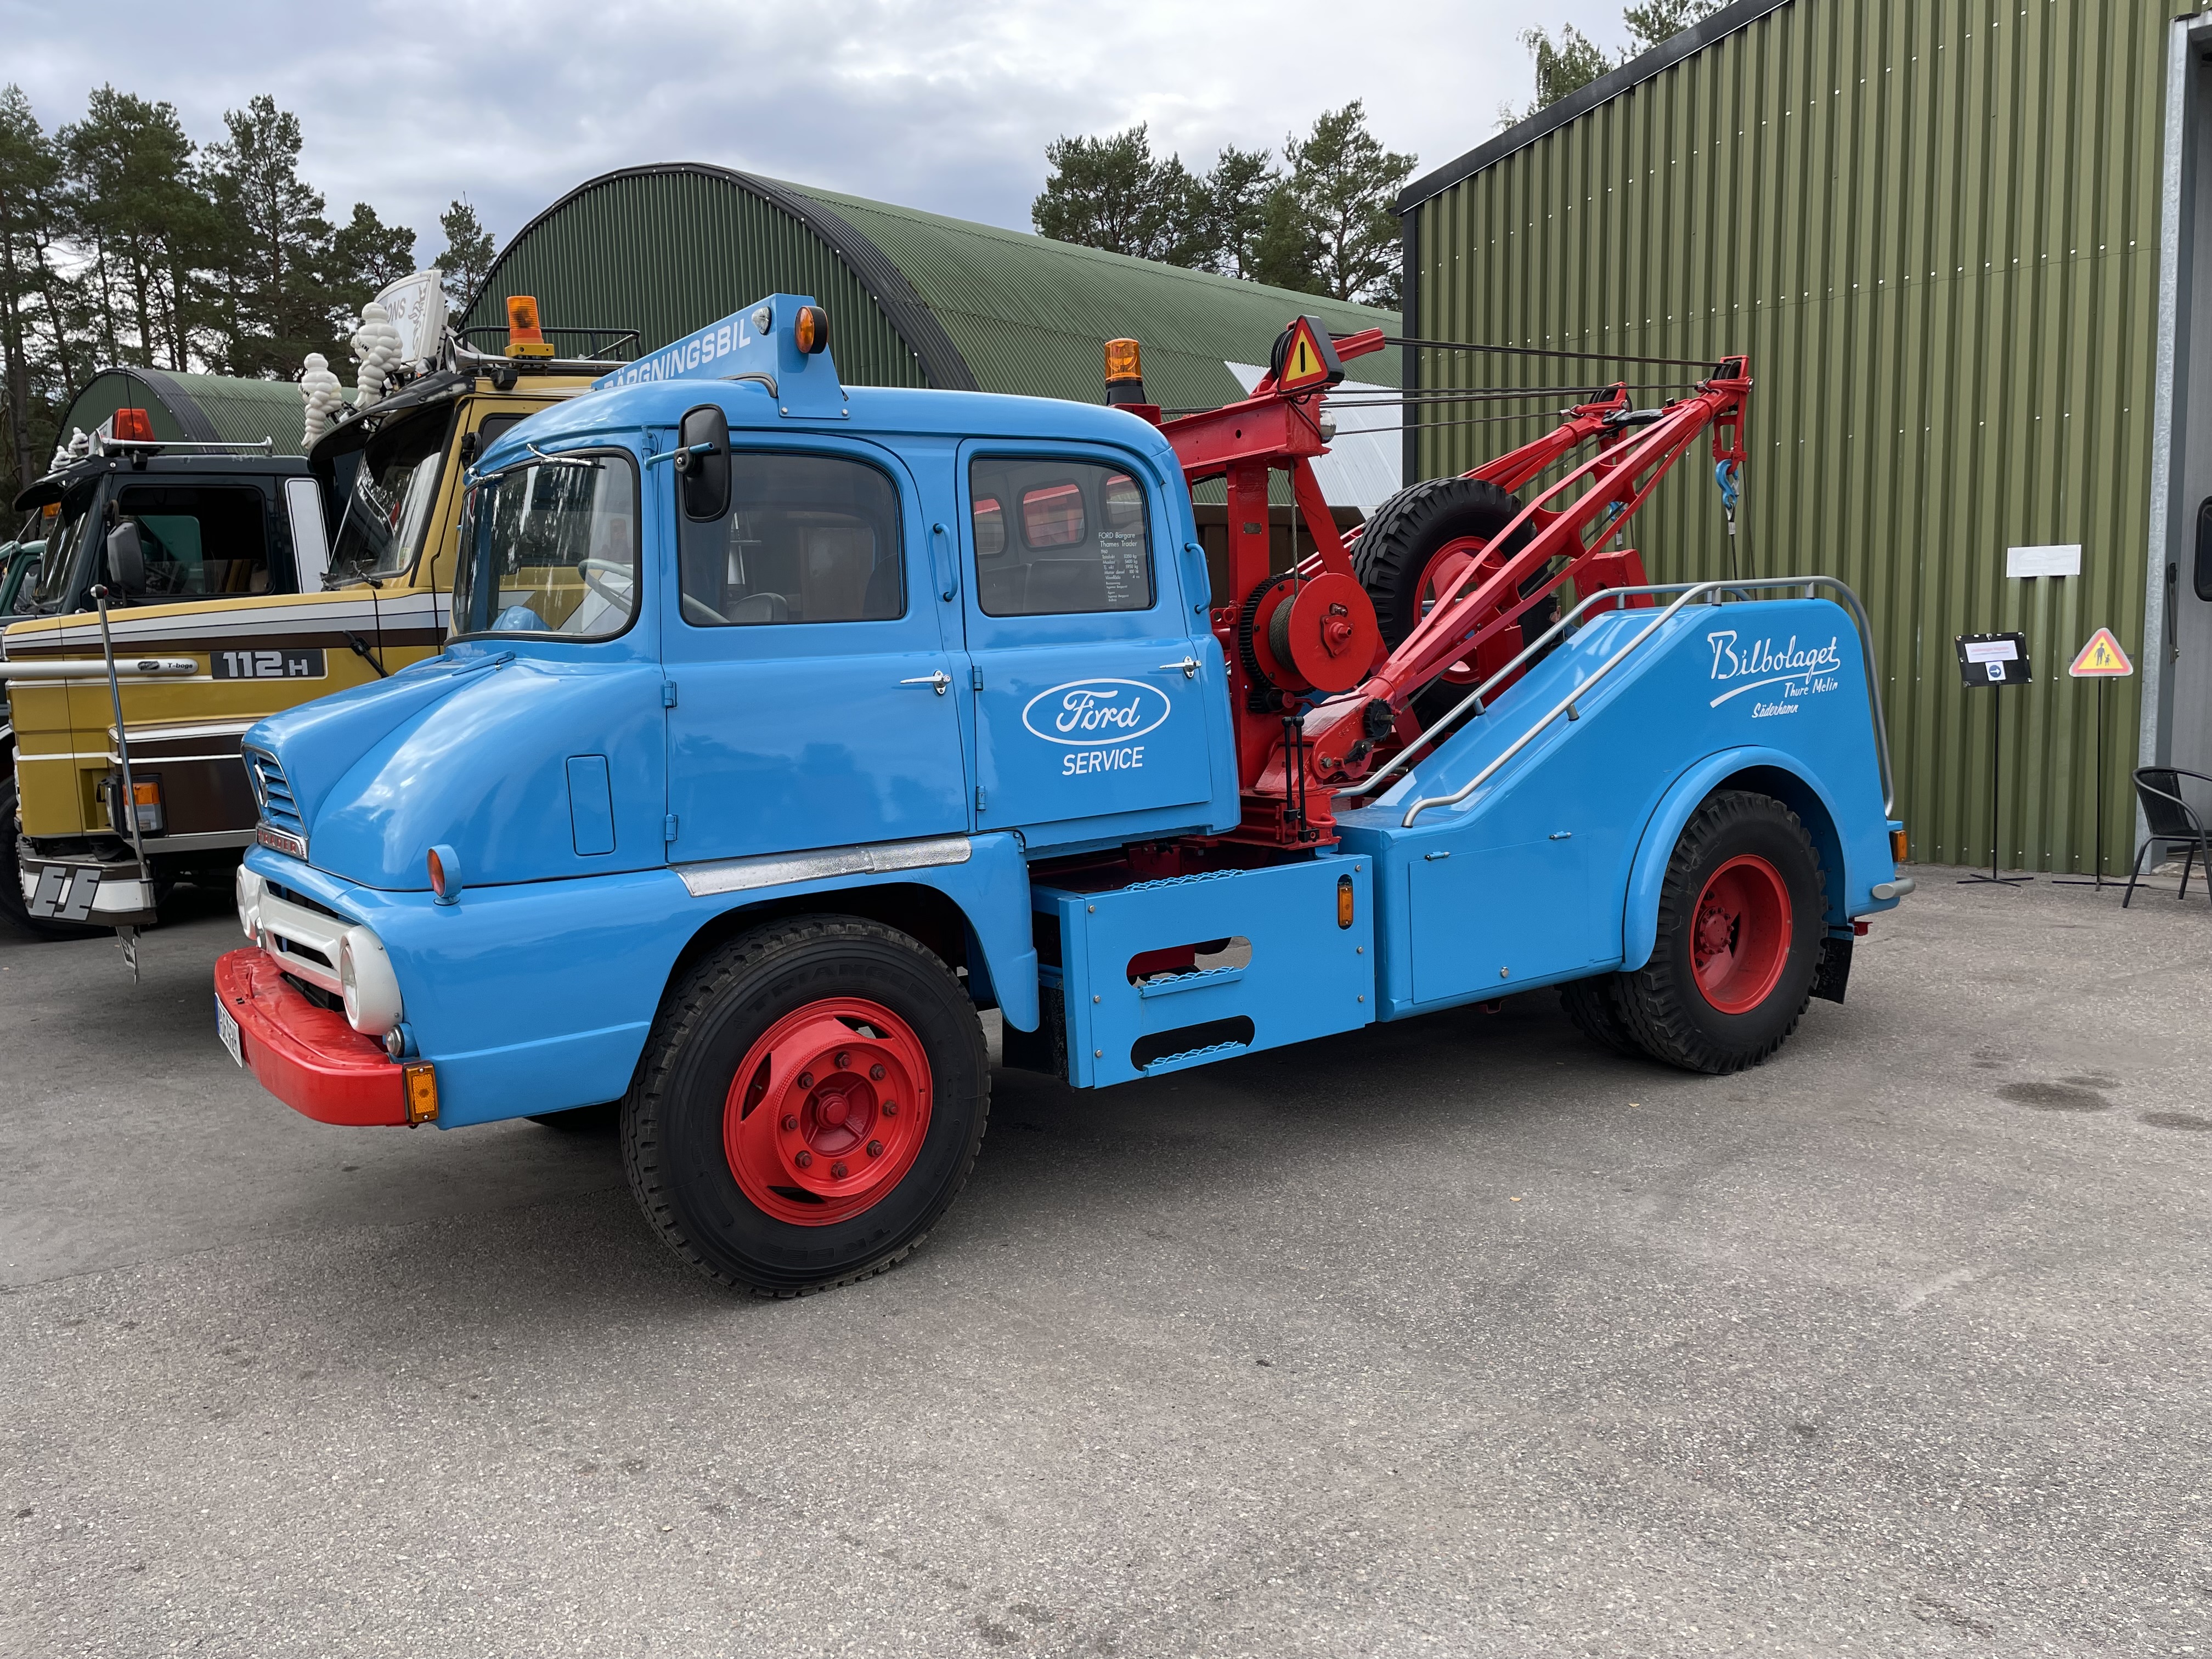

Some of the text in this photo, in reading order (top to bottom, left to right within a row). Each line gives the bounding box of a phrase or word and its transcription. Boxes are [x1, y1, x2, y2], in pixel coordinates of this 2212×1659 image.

[1115, 532, 1136, 540] Bärgare
[1707, 630, 1841, 685] Bilbolaget
[1784, 677, 1838, 698] Thure Melin
[1056, 690, 1141, 732] Ford
[1752, 701, 1799, 718] Söderhamn
[1062, 746, 1145, 776] SERVICE
[258, 830, 297, 854] TRADER
[746, 964, 928, 1013] TRIANGLE
